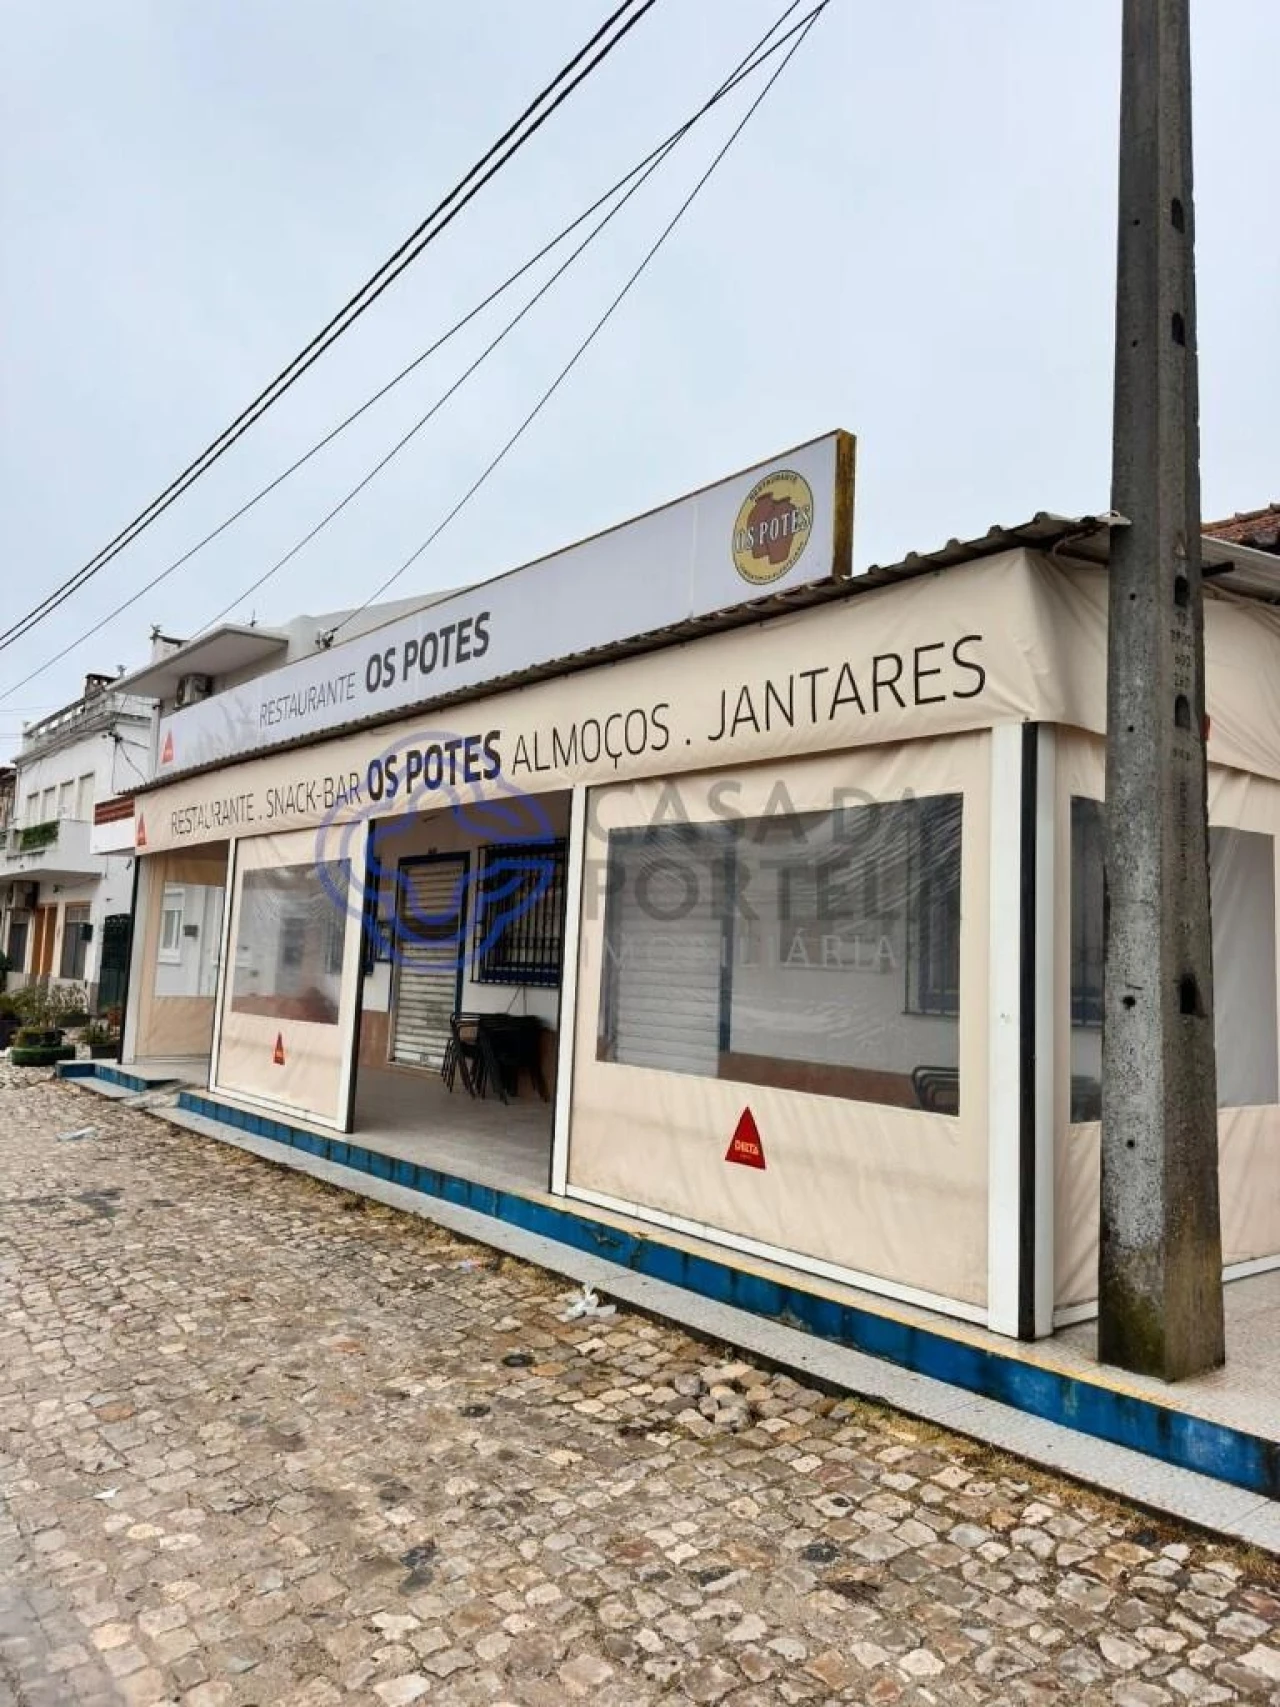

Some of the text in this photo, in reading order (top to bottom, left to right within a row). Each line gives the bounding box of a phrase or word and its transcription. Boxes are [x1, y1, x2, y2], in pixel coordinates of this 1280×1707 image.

[760, 505, 811, 545] POTES
[259, 611, 491, 729] RESTAURANTE OS POTES
[171, 792, 255, 836] RESTAURANTE
[266, 772, 360, 819] SNACK-BAR
[367, 753, 398, 801] OS
[406, 729, 501, 794] POTES
[511, 702, 669, 775] ALMOÇOS
[708, 634, 986, 742] JANTARES
